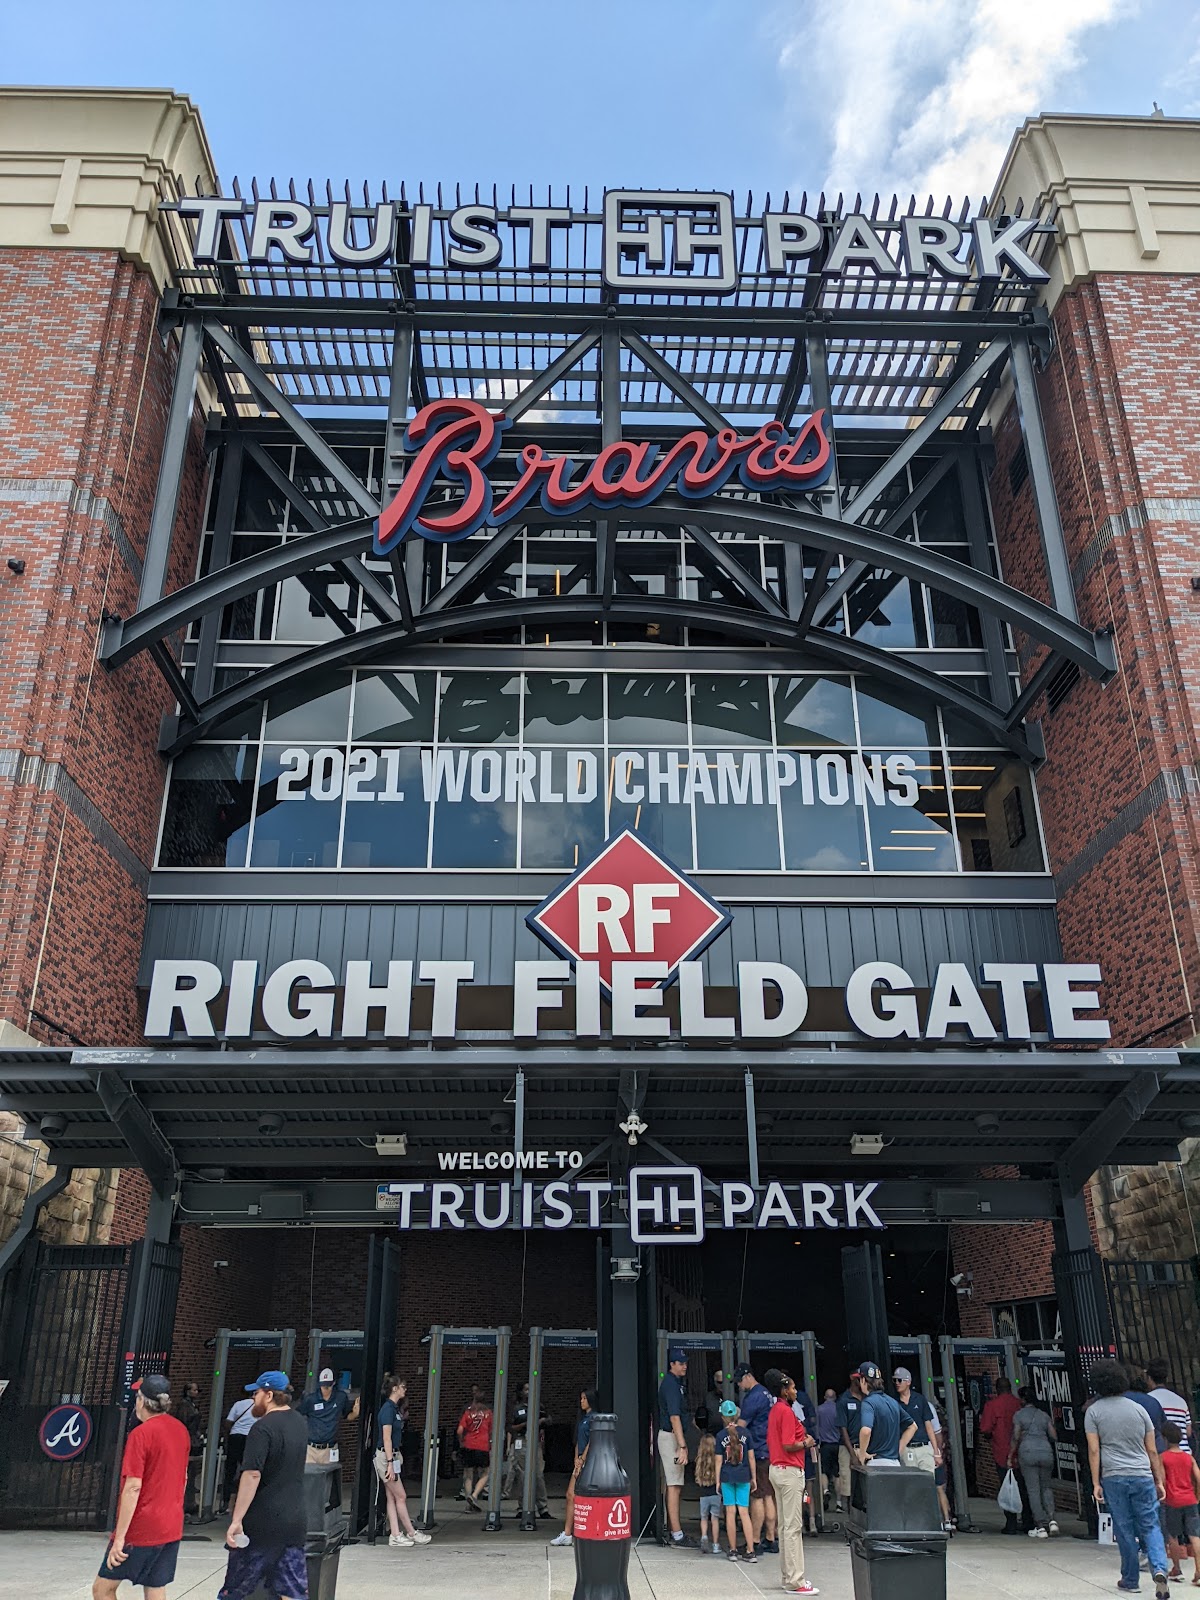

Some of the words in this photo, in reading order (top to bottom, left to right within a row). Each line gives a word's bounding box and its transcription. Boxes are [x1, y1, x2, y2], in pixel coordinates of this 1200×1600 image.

[178, 198, 573, 269] TRUIST
[763, 211, 1051, 285] PARK
[374, 398, 831, 555] Braves
[276, 748, 404, 802] 2021
[420, 749, 598, 803] WORLD
[614, 751, 920, 807] CHAMPIONS
[577, 883, 680, 954] RF
[144, 959, 475, 1038] RIGHT
[513, 960, 809, 1038] FIELD
[846, 961, 1111, 1040] GATE
[437, 1151, 549, 1171] WELCOME
[555, 1150, 584, 1169] TO
[388, 1181, 613, 1230] TRUIST
[721, 1181, 886, 1229] PARK
[46, 1411, 82, 1448] A
